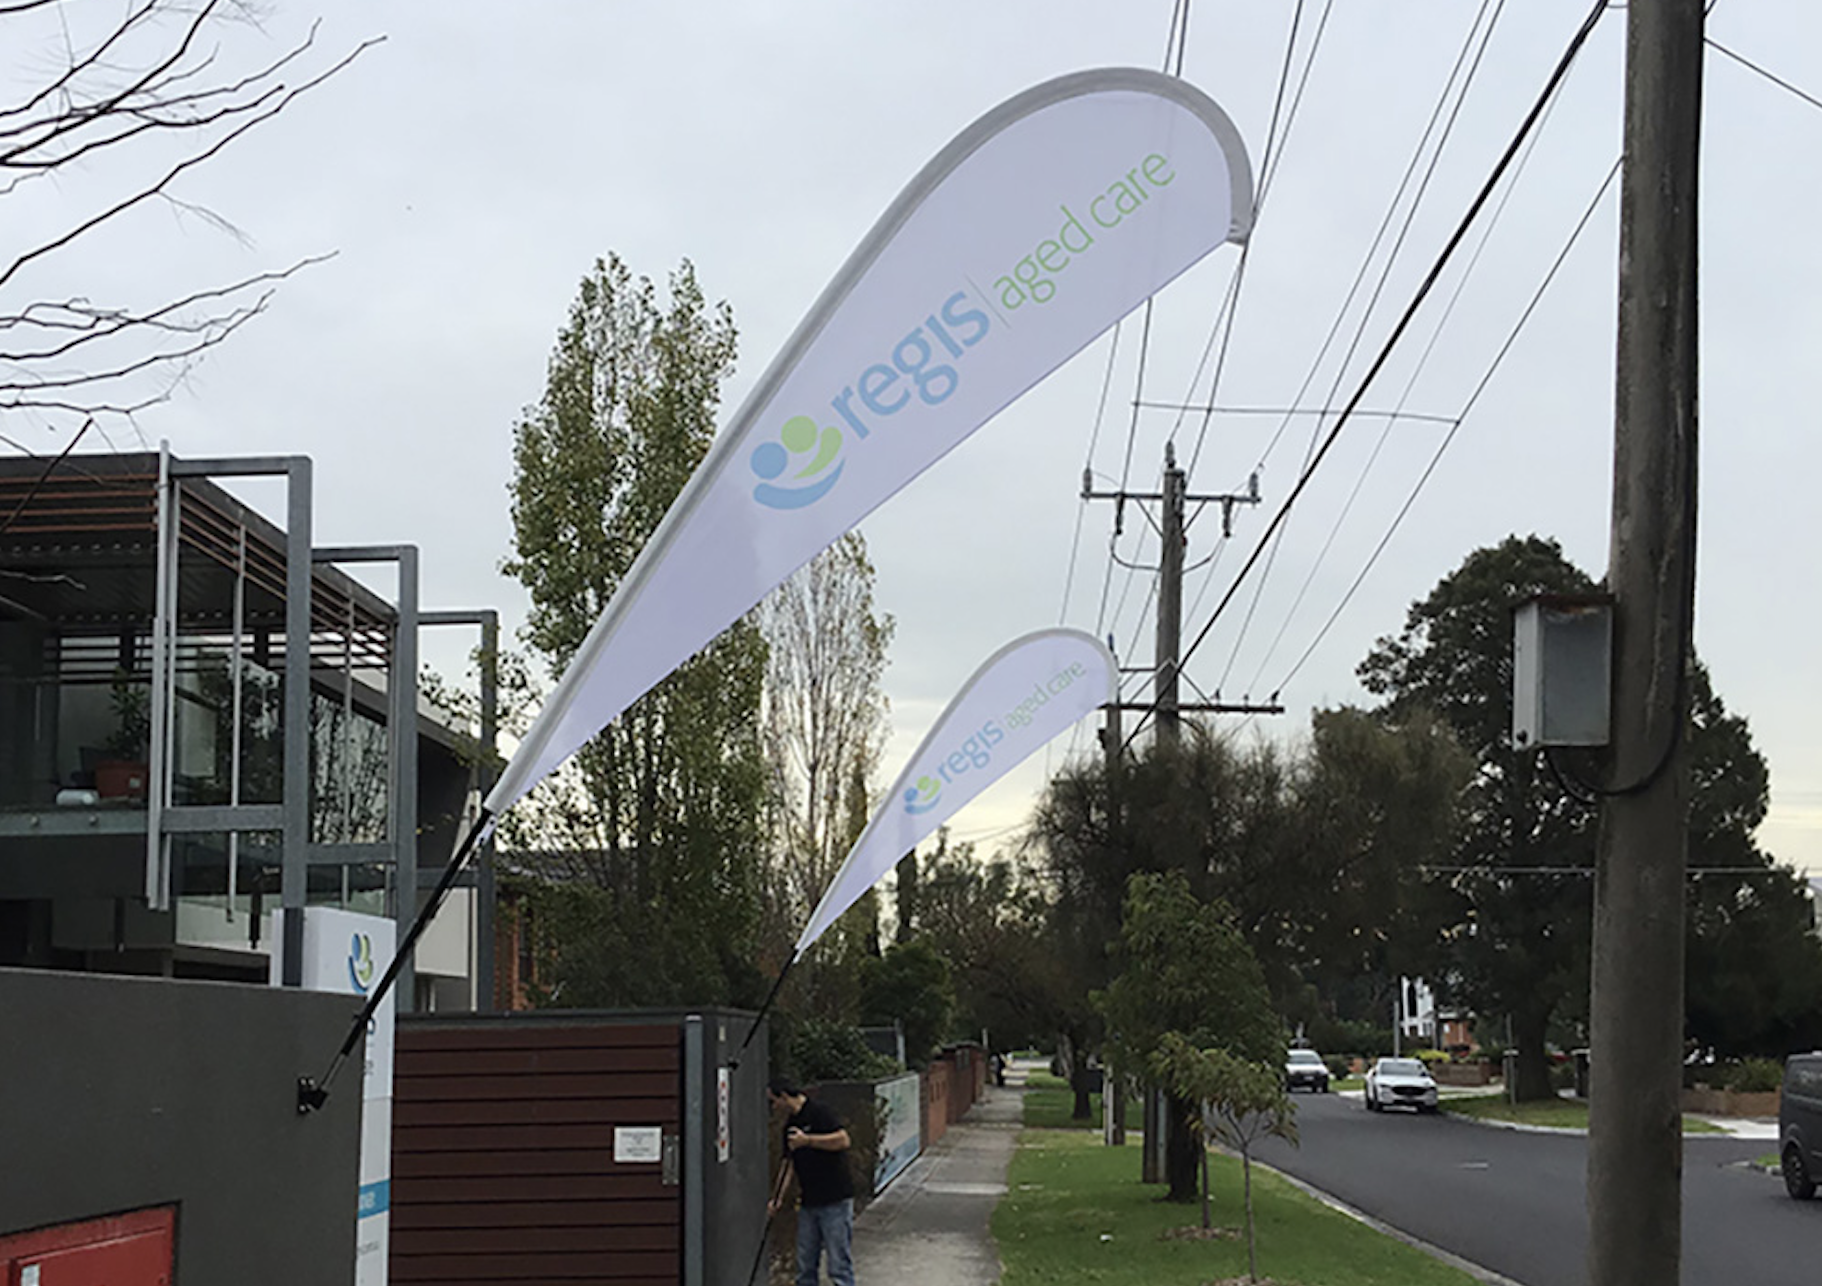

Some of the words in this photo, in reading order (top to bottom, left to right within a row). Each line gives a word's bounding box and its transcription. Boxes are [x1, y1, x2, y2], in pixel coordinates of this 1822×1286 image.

[831, 291, 990, 440] regis
[993, 204, 1095, 309] aged
[1090, 153, 1175, 228] care
[938, 720, 1004, 784] regis
[1005, 683, 1048, 728] aged
[1047, 662, 1086, 695] care
